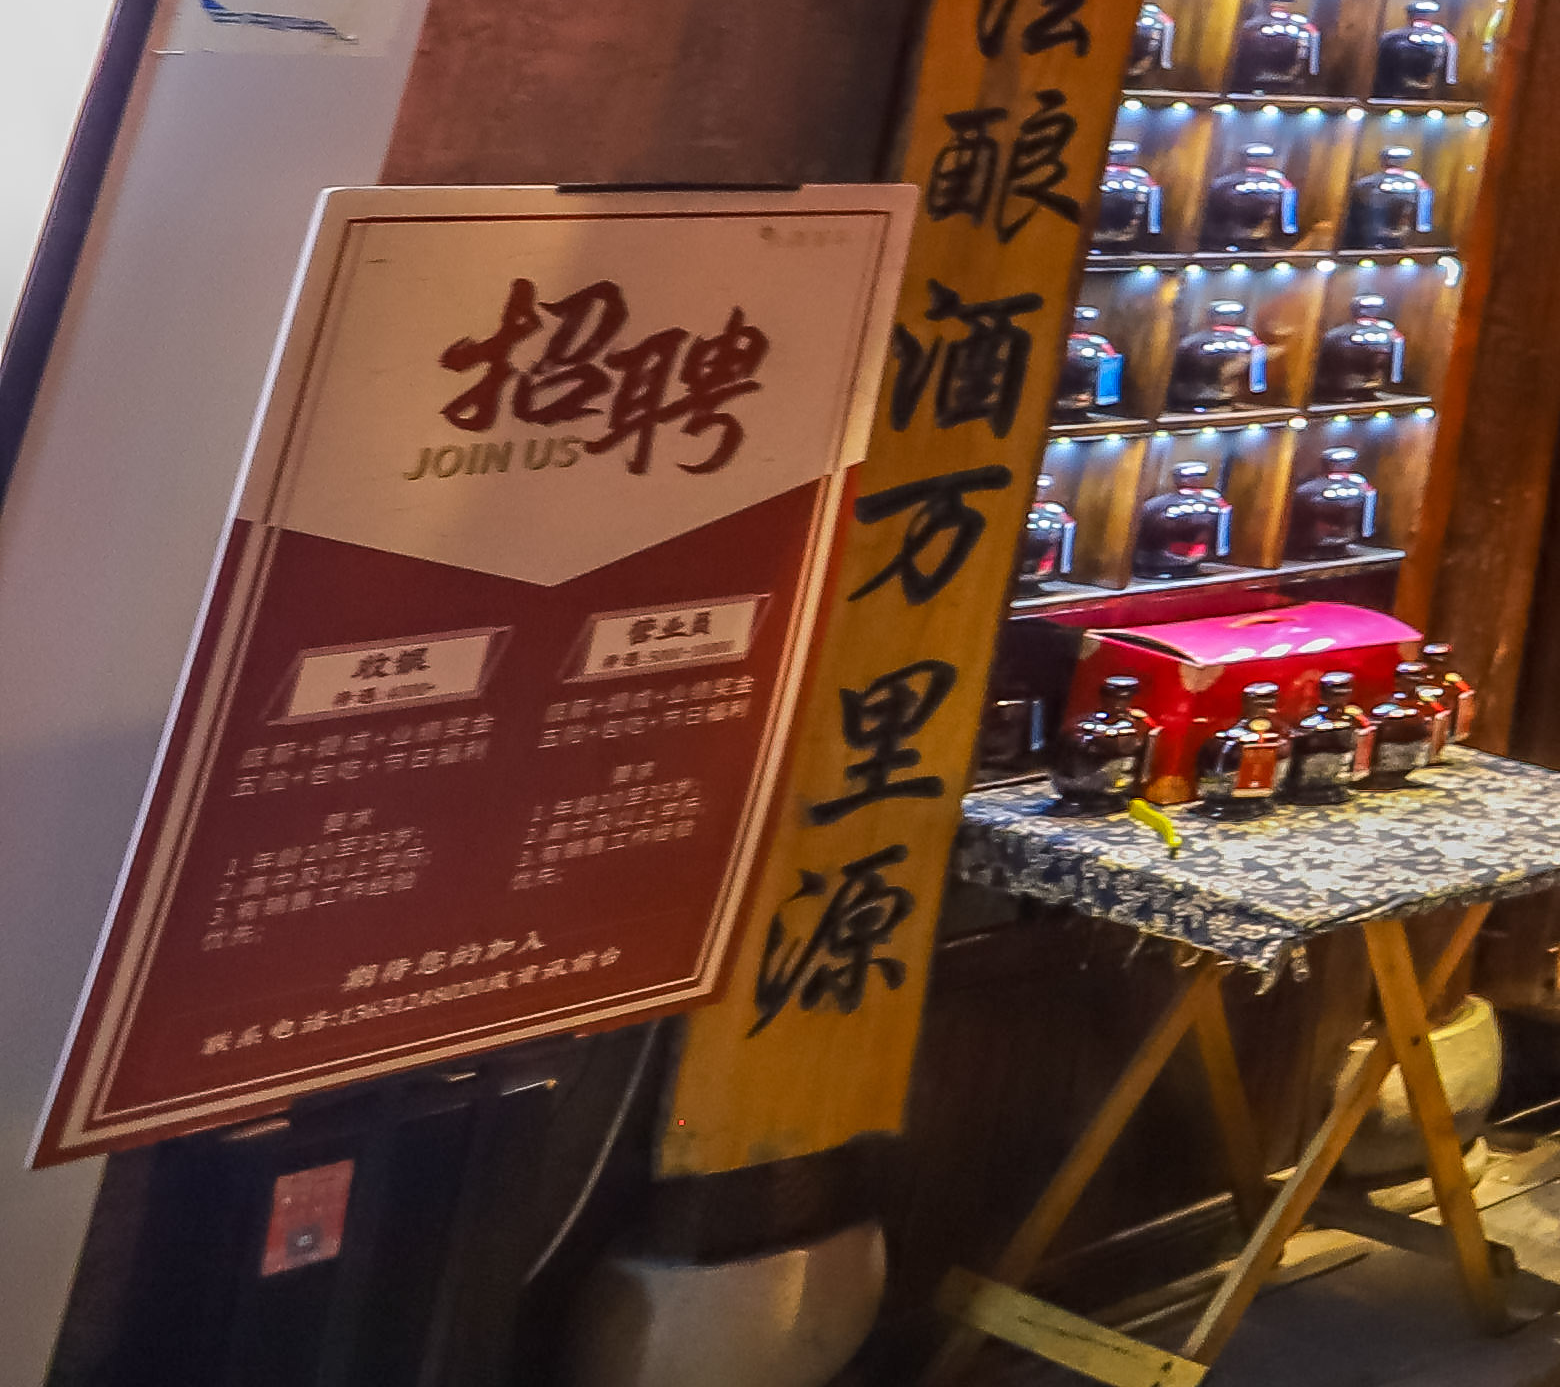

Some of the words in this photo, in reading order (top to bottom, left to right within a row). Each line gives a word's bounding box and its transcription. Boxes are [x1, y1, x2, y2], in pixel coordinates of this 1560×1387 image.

[438, 277, 770, 477] 招聘
[403, 441, 518, 483] JOIN
[522, 436, 586, 475] US
